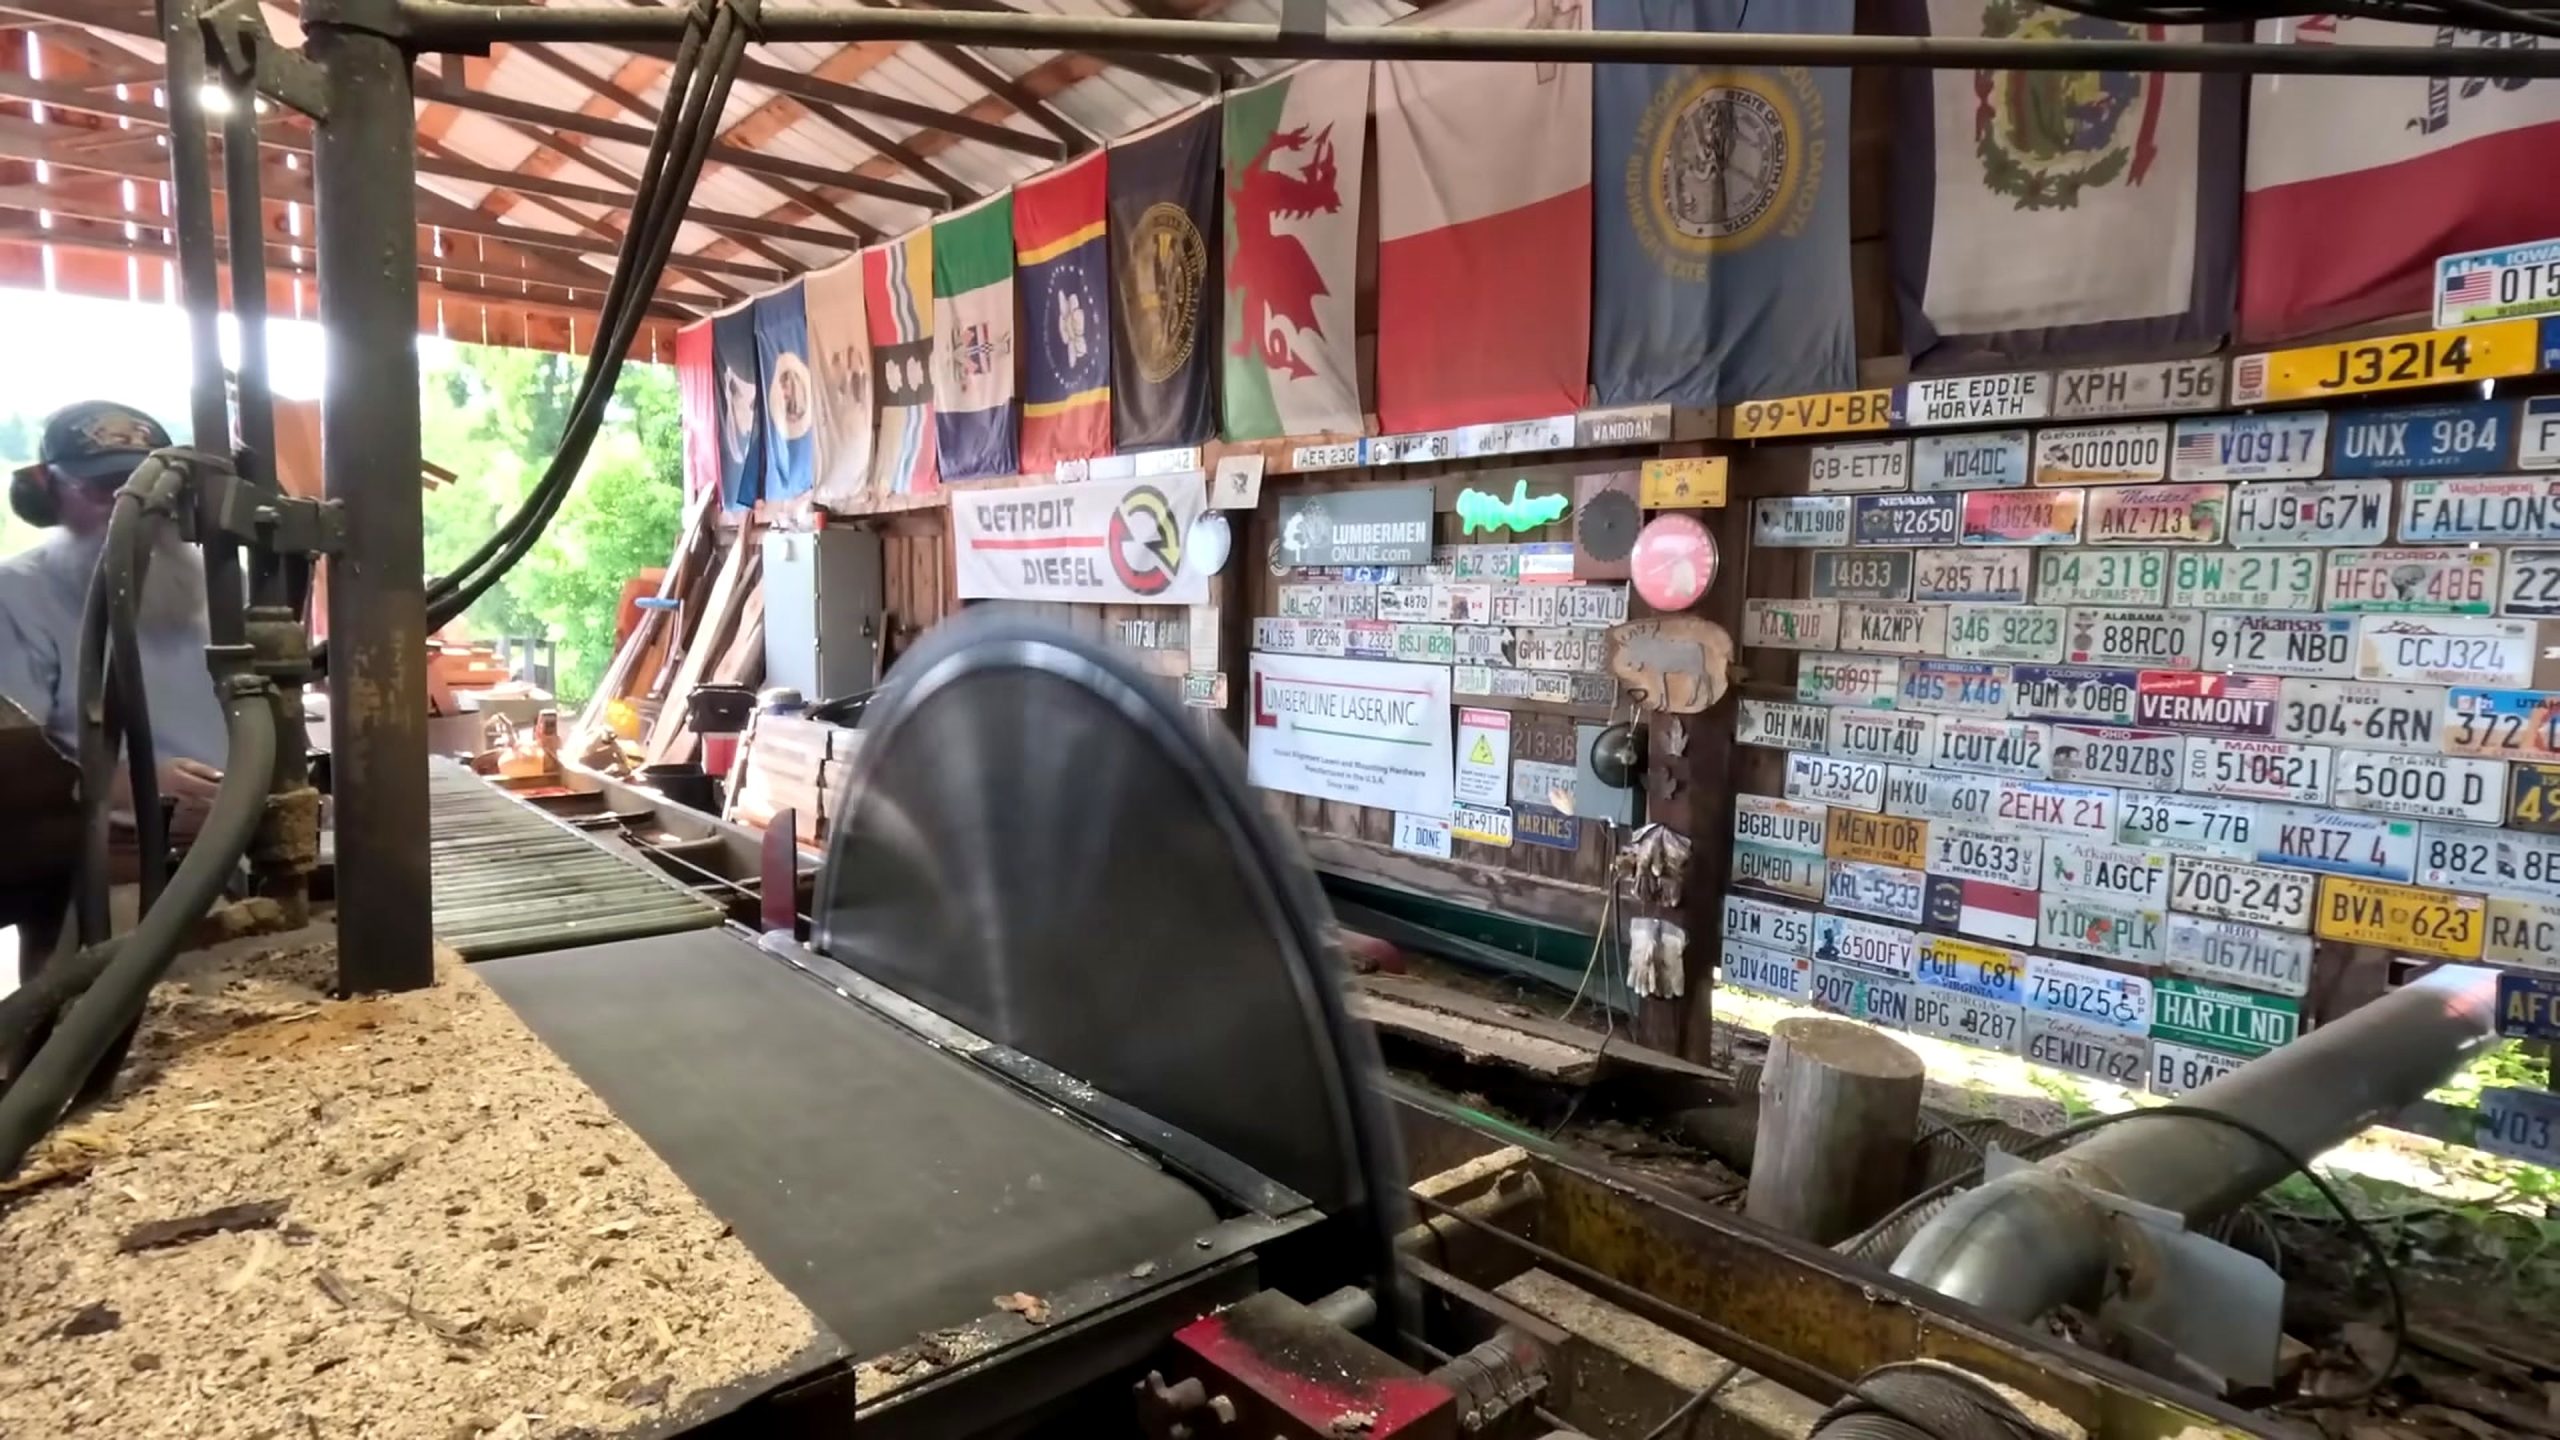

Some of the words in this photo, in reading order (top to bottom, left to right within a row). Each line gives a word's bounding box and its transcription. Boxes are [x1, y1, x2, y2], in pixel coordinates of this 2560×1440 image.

[2318, 335, 2472, 390] J3214
[1920, 380, 1957, 401] THE
[1968, 375, 2036, 397] EDDIE
[2064, 371, 2127, 405] XPH
[2159, 366, 2214, 400] 156
[1744, 393, 1891, 434] 99-VJ-BR
[1926, 396, 2024, 420] HORVATH
[1591, 419, 1652, 443] WANDOAN
[2039, 428, 2118, 442] GEORGIA
[2345, 421, 2410, 458] UNX
[2431, 417, 2498, 454] 984
[1812, 452, 1902, 480] GB-ET78
[976, 496, 1076, 533] DETROIT
[1878, 494, 1937, 507] NEVADA
[2236, 495, 2297, 532] HJ9
[2315, 493, 2380, 530] G7W
[1332, 521, 1427, 545] LUMBERMEN
[1903, 507, 1954, 535] 2650
[1331, 546, 1412, 563] ONLINE.com
[2371, 551, 2450, 561] FLORIDA
[1021, 556, 1104, 588] DIESEL
[1930, 565, 1972, 592] 285
[1984, 565, 2021, 593] 711
[2096, 556, 2160, 587] 318
[2176, 556, 2224, 590] 8W
[2239, 557, 2314, 591] 213
[2335, 568, 2388, 599] HFG
[1558, 596, 1588, 618] 613
[2103, 613, 2164, 623] ALABAMA
[1951, 616, 1990, 642] 346
[2002, 617, 2058, 645] 9223
[2241, 614, 2322, 633] Arkansas
[1518, 639, 1582, 662] GPH-203
[2211, 630, 2266, 660] 912
[2398, 637, 2505, 671] CCJ324
[1928, 662, 1983, 673] MICHIGAN
[1763, 711, 1785, 734] OH
[1790, 713, 1825, 742] MAN
[2142, 694, 2270, 727] VERMONT
[2286, 702, 2347, 737] 304
[2364, 706, 2433, 743] 6RN
[1843, 722, 1920, 756] ICUT4U
[2098, 729, 2132, 740] OHIO
[2454, 711, 2523, 749] 372
[1940, 731, 2042, 770] ICUT4U2
[2224, 741, 2290, 755] MAINE
[2388, 755, 2449, 769] MAINE
[2215, 751, 2320, 790] 510521
[2354, 764, 2447, 801] 5000
[2461, 773, 2484, 805] D
[1890, 779, 1927, 805] HXU
[1951, 787, 1991, 813] 607
[1998, 790, 2066, 826] 2EHX
[2073, 798, 2106, 831] 21
[1517, 813, 1573, 839] MARINES
[1835, 814, 1921, 855] MENTOR
[2280, 823, 2351, 863] KRIZ
[2370, 836, 2387, 868] 4
[2429, 840, 2490, 875] 882
[1740, 852, 1793, 884] GUMBO
[2095, 861, 2165, 895] AGCF
[1828, 871, 1921, 911] KRL-5233
[2175, 867, 2305, 916] 700-243
[1726, 907, 1761, 936] DIM
[1773, 918, 1808, 946] 255
[2331, 892, 2385, 930] BVA
[2411, 904, 2470, 943] 623
[2114, 917, 2157, 951] PLK
[1816, 974, 1854, 1000] 907
[1868, 986, 1908, 1021] GRN
[1942, 977, 1994, 999] VIRGINIA
[2031, 974, 2112, 1016] 75025
[2194, 984, 2253, 1004] Vermont
[1914, 997, 1950, 1027] BPG
[2163, 993, 2286, 1048] HARTLND
[2030, 1033, 2140, 1083] 6EWU762
[2159, 1055, 2175, 1085] B
